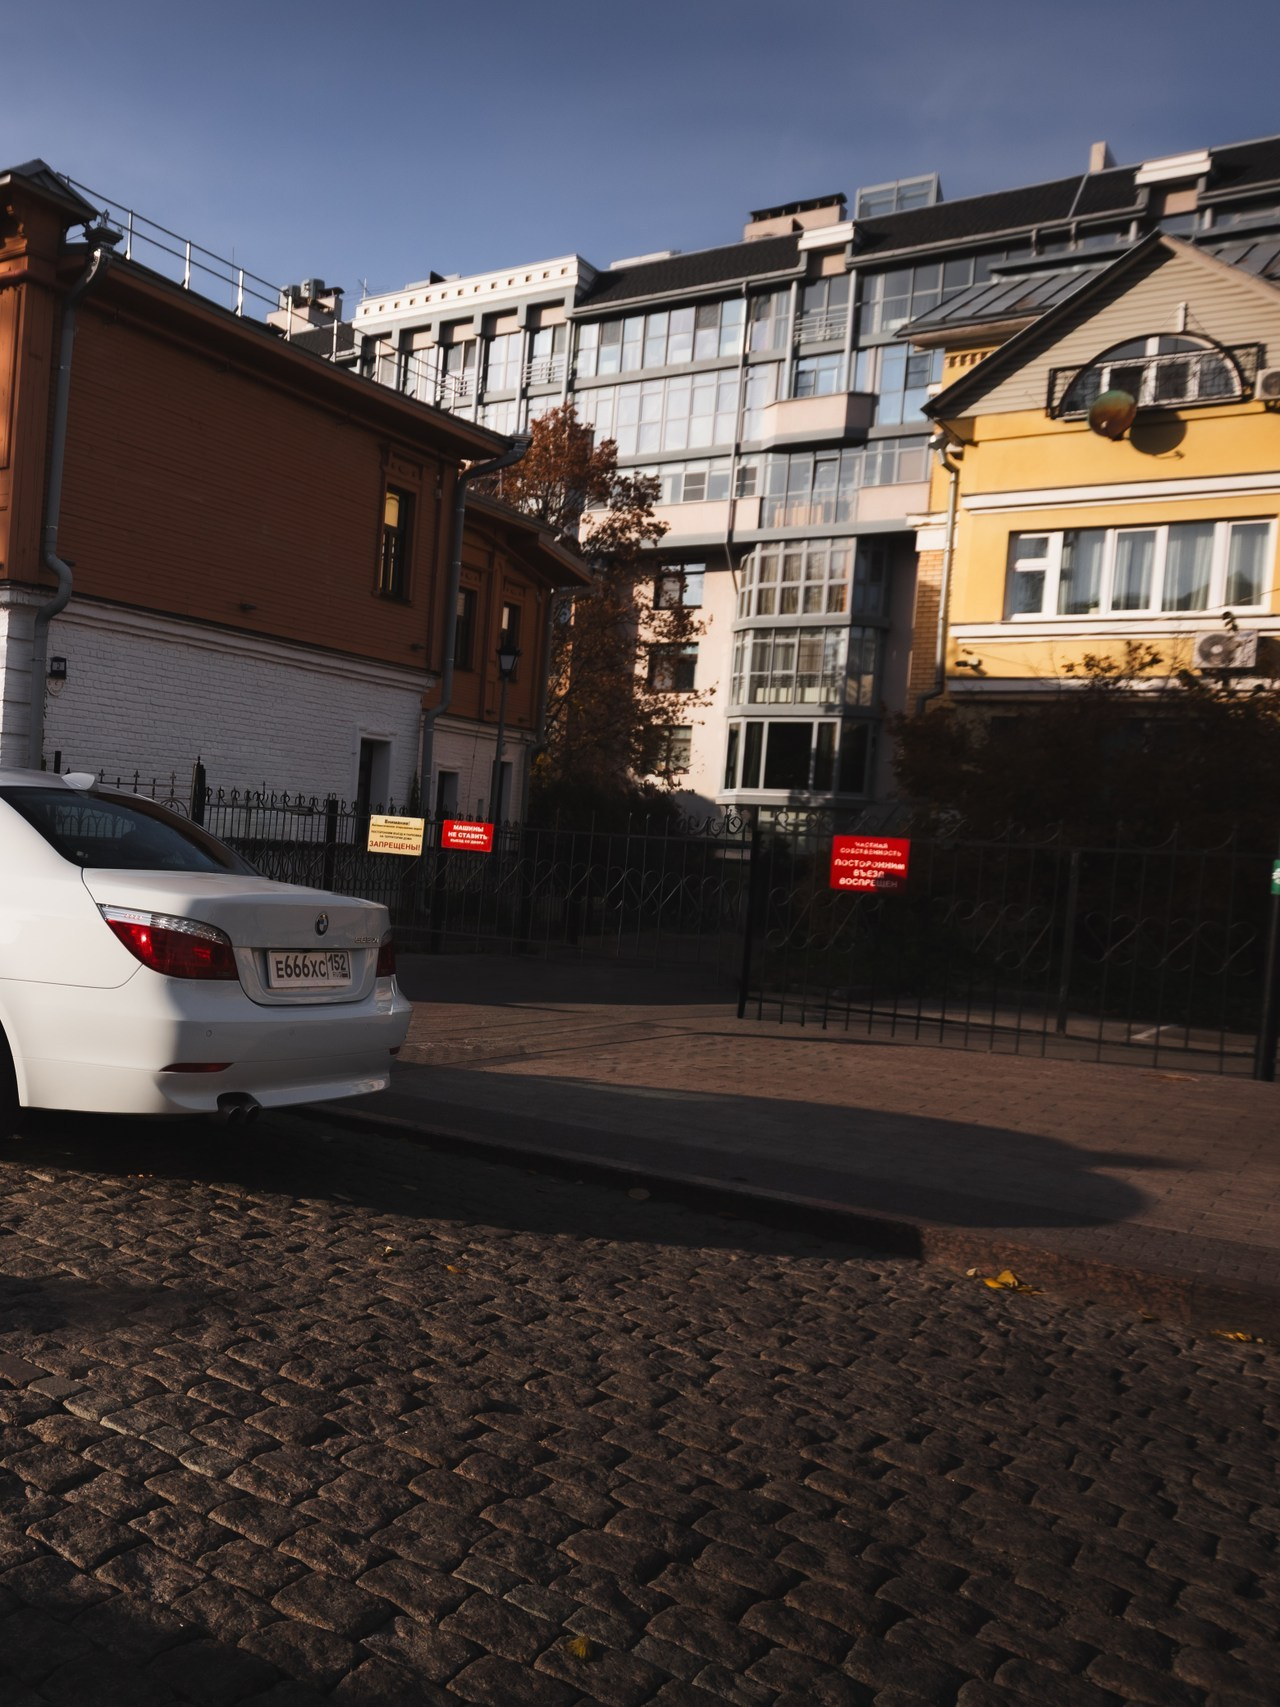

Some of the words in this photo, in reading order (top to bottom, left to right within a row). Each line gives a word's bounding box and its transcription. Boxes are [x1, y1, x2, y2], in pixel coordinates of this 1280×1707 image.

[458, 832, 488, 840] СТАВИТЬ
[369, 840, 420, 851] ЗАПРЕЩЕНЫ!
[854, 841, 888, 849] ЧАСТНАЯ
[840, 847, 902, 857] СОБСТВЕННОСТЬ
[834, 858, 905, 870] ПОСТОРОННИМ
[853, 869, 885, 878] ВЪЕЗД
[838, 877, 898, 888] ВОСПРЕЩЕН
